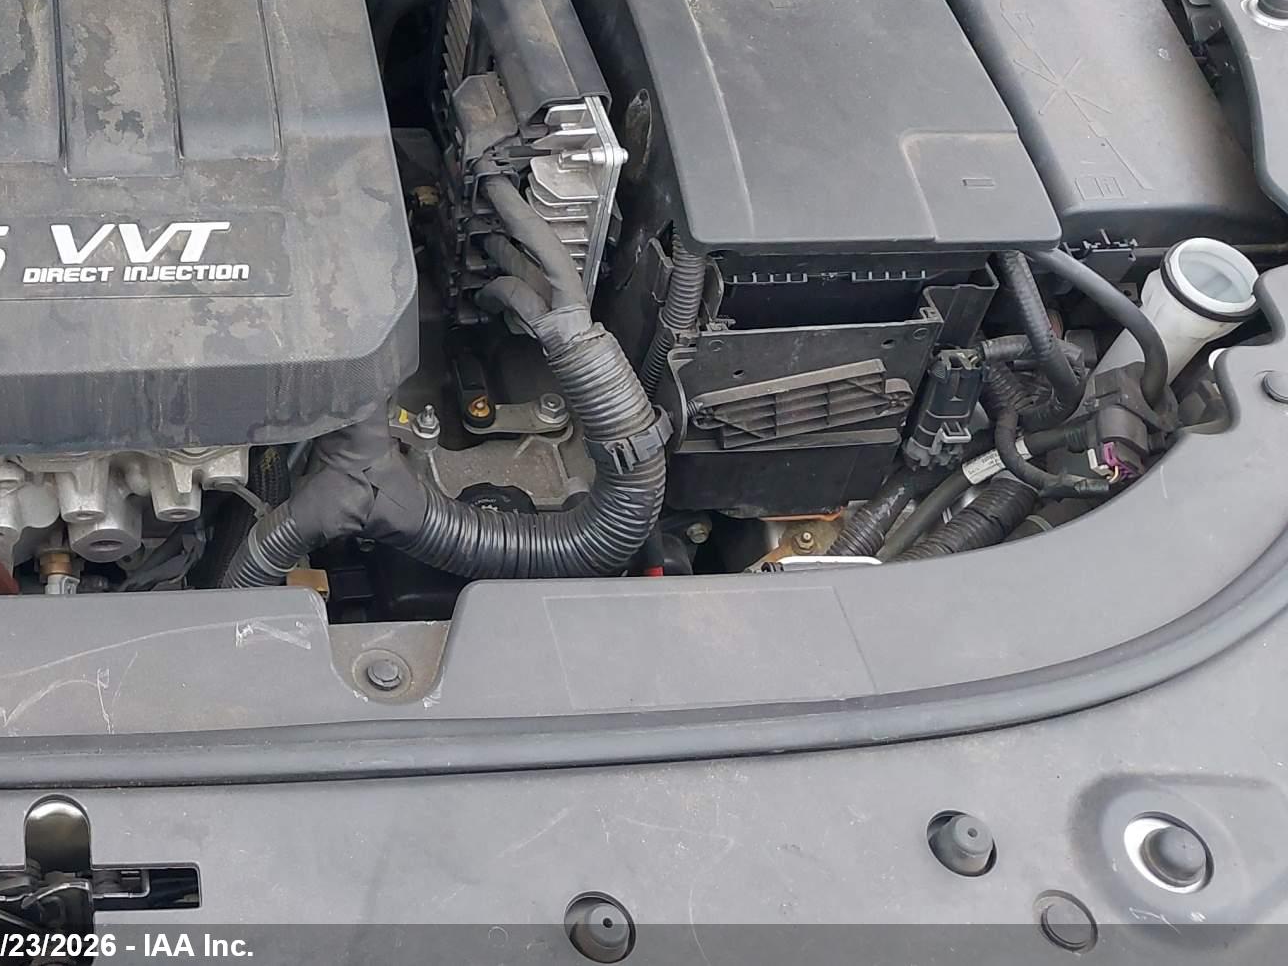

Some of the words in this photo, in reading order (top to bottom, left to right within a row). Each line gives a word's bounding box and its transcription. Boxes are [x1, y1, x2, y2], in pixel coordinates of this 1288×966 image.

[51, 222, 229, 264] VVT
[23, 267, 113, 282] DIRECT
[124, 265, 249, 283] INJECTION
